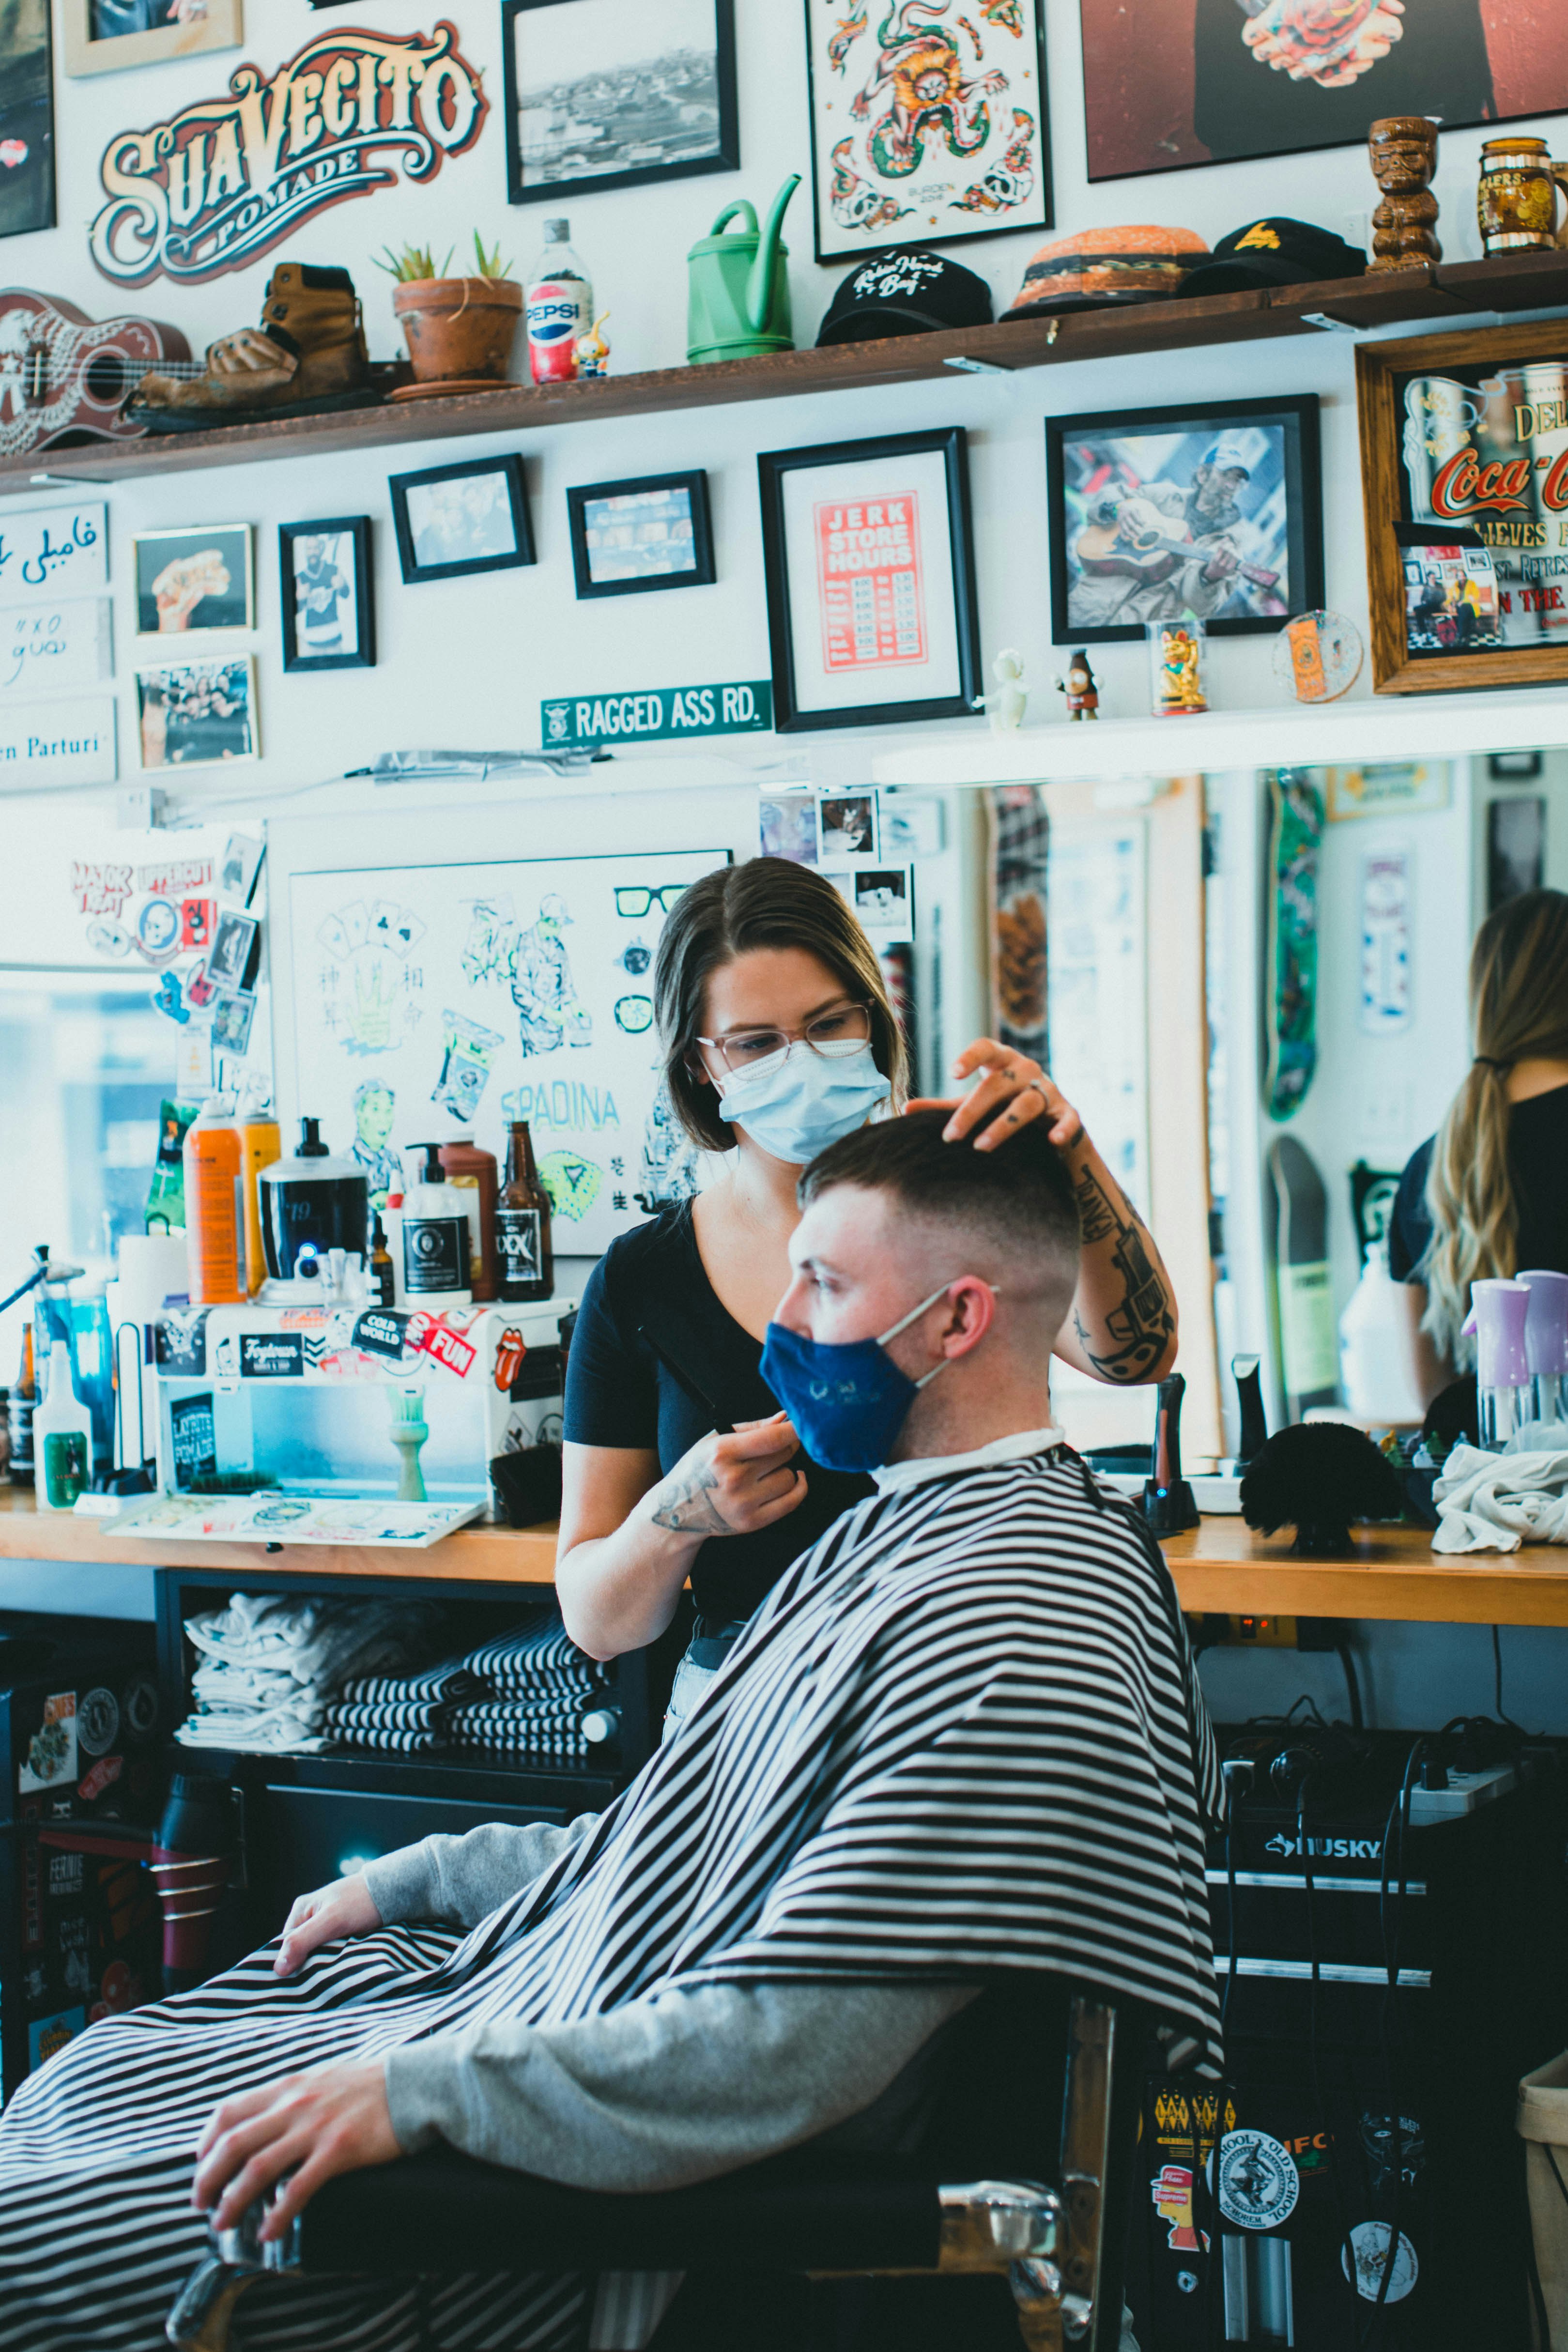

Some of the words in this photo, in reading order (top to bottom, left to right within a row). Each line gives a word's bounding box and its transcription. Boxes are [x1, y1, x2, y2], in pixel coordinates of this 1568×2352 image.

[92, 25, 482, 276] SUAVECITO
[214, 149, 359, 251] POMADE
[829, 502, 907, 531] JERK
[829, 523, 909, 553] STORE
[829, 545, 913, 574] HOURS
[1518, 585, 1566, 613] THE
[576, 694, 663, 738] RAGGED
[671, 689, 716, 728] ASS
[722, 686, 760, 723] RD.
[28, 732, 98, 757] Parturi
[501, 1081, 620, 1131] SPADINA
[359, 1323, 401, 1346] WORLD
[366, 1314, 397, 1333] COLD
[430, 1329, 472, 1373] FUN
[1296, 1837, 1380, 1859] HUSKY
[1220, 2134, 1254, 2163] HOOL
[1268, 2141, 1290, 2167] OLD
[1268, 2169, 1297, 2221] SCHOOL
